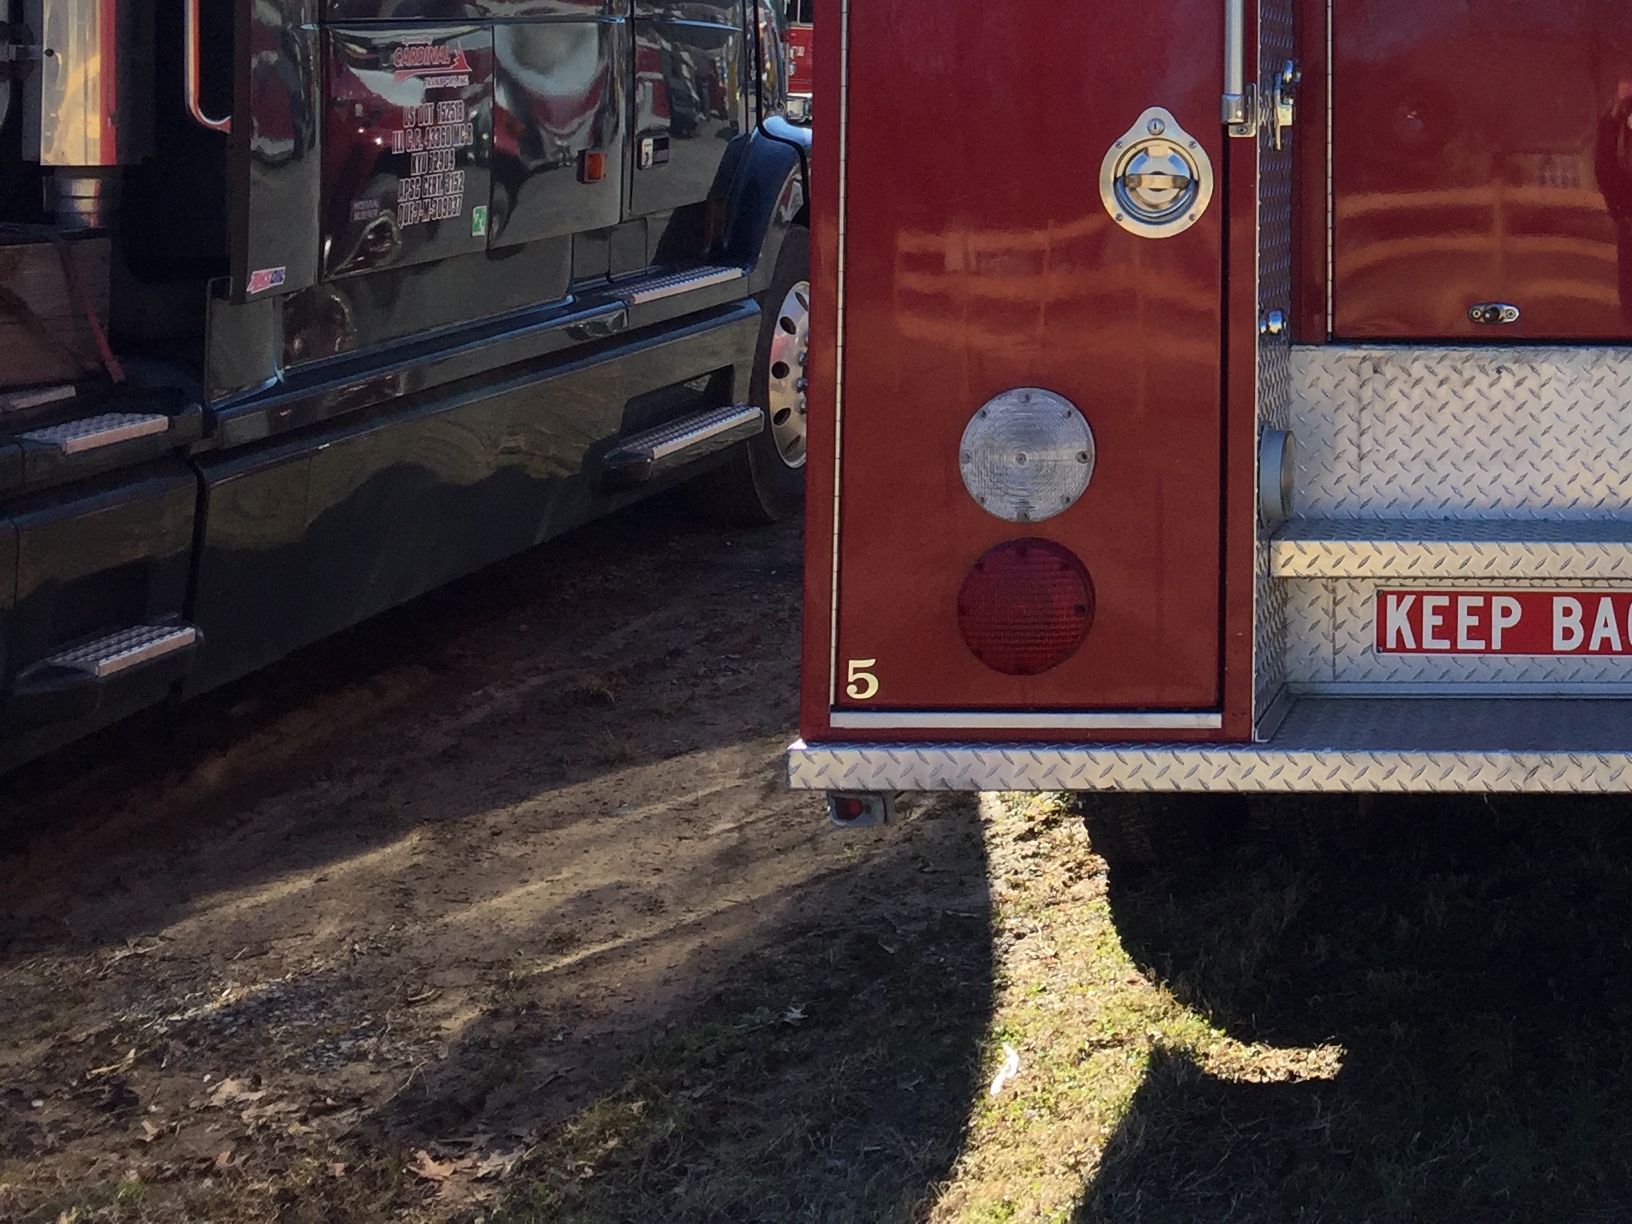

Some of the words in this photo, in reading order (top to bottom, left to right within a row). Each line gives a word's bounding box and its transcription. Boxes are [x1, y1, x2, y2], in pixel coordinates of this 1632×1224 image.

[394, 46, 451, 67] CARDINAL
[403, 106, 416, 127] US
[418, 102, 434, 126] DOT
[411, 151, 428, 176] KYU
[1385, 594, 1523, 650] KEEP
[846, 659, 879, 700] 5
